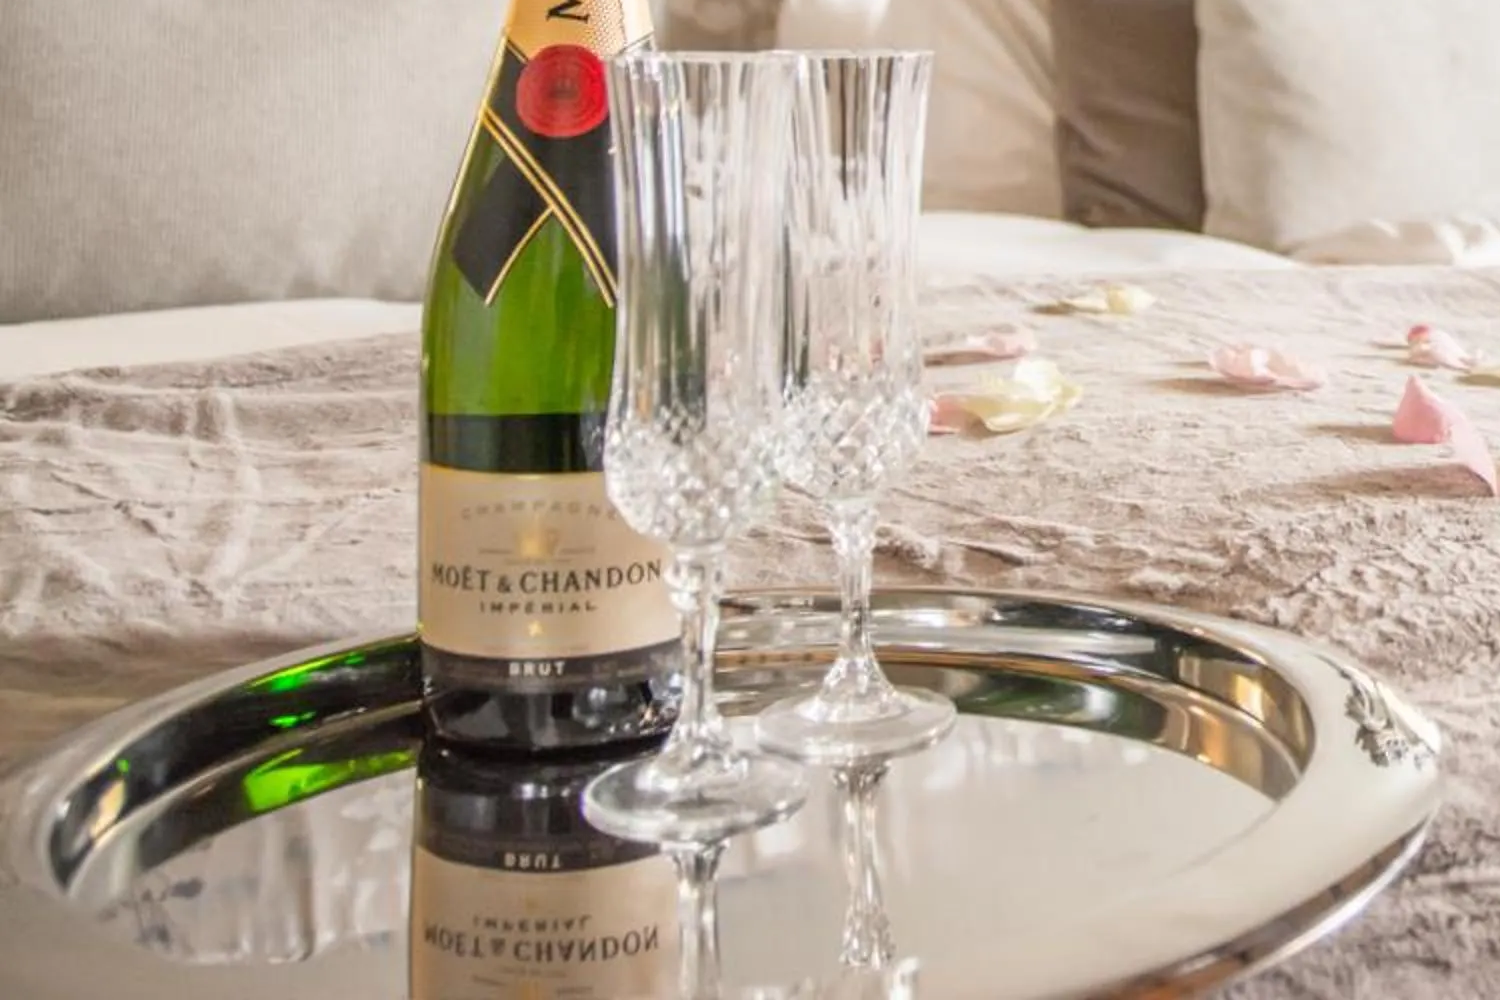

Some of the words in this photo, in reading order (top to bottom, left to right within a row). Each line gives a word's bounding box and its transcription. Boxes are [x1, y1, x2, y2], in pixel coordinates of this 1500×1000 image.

[497, 574, 511, 594] &
[519, 559, 662, 594] CHANDON
[509, 661, 566, 676] BRUT
